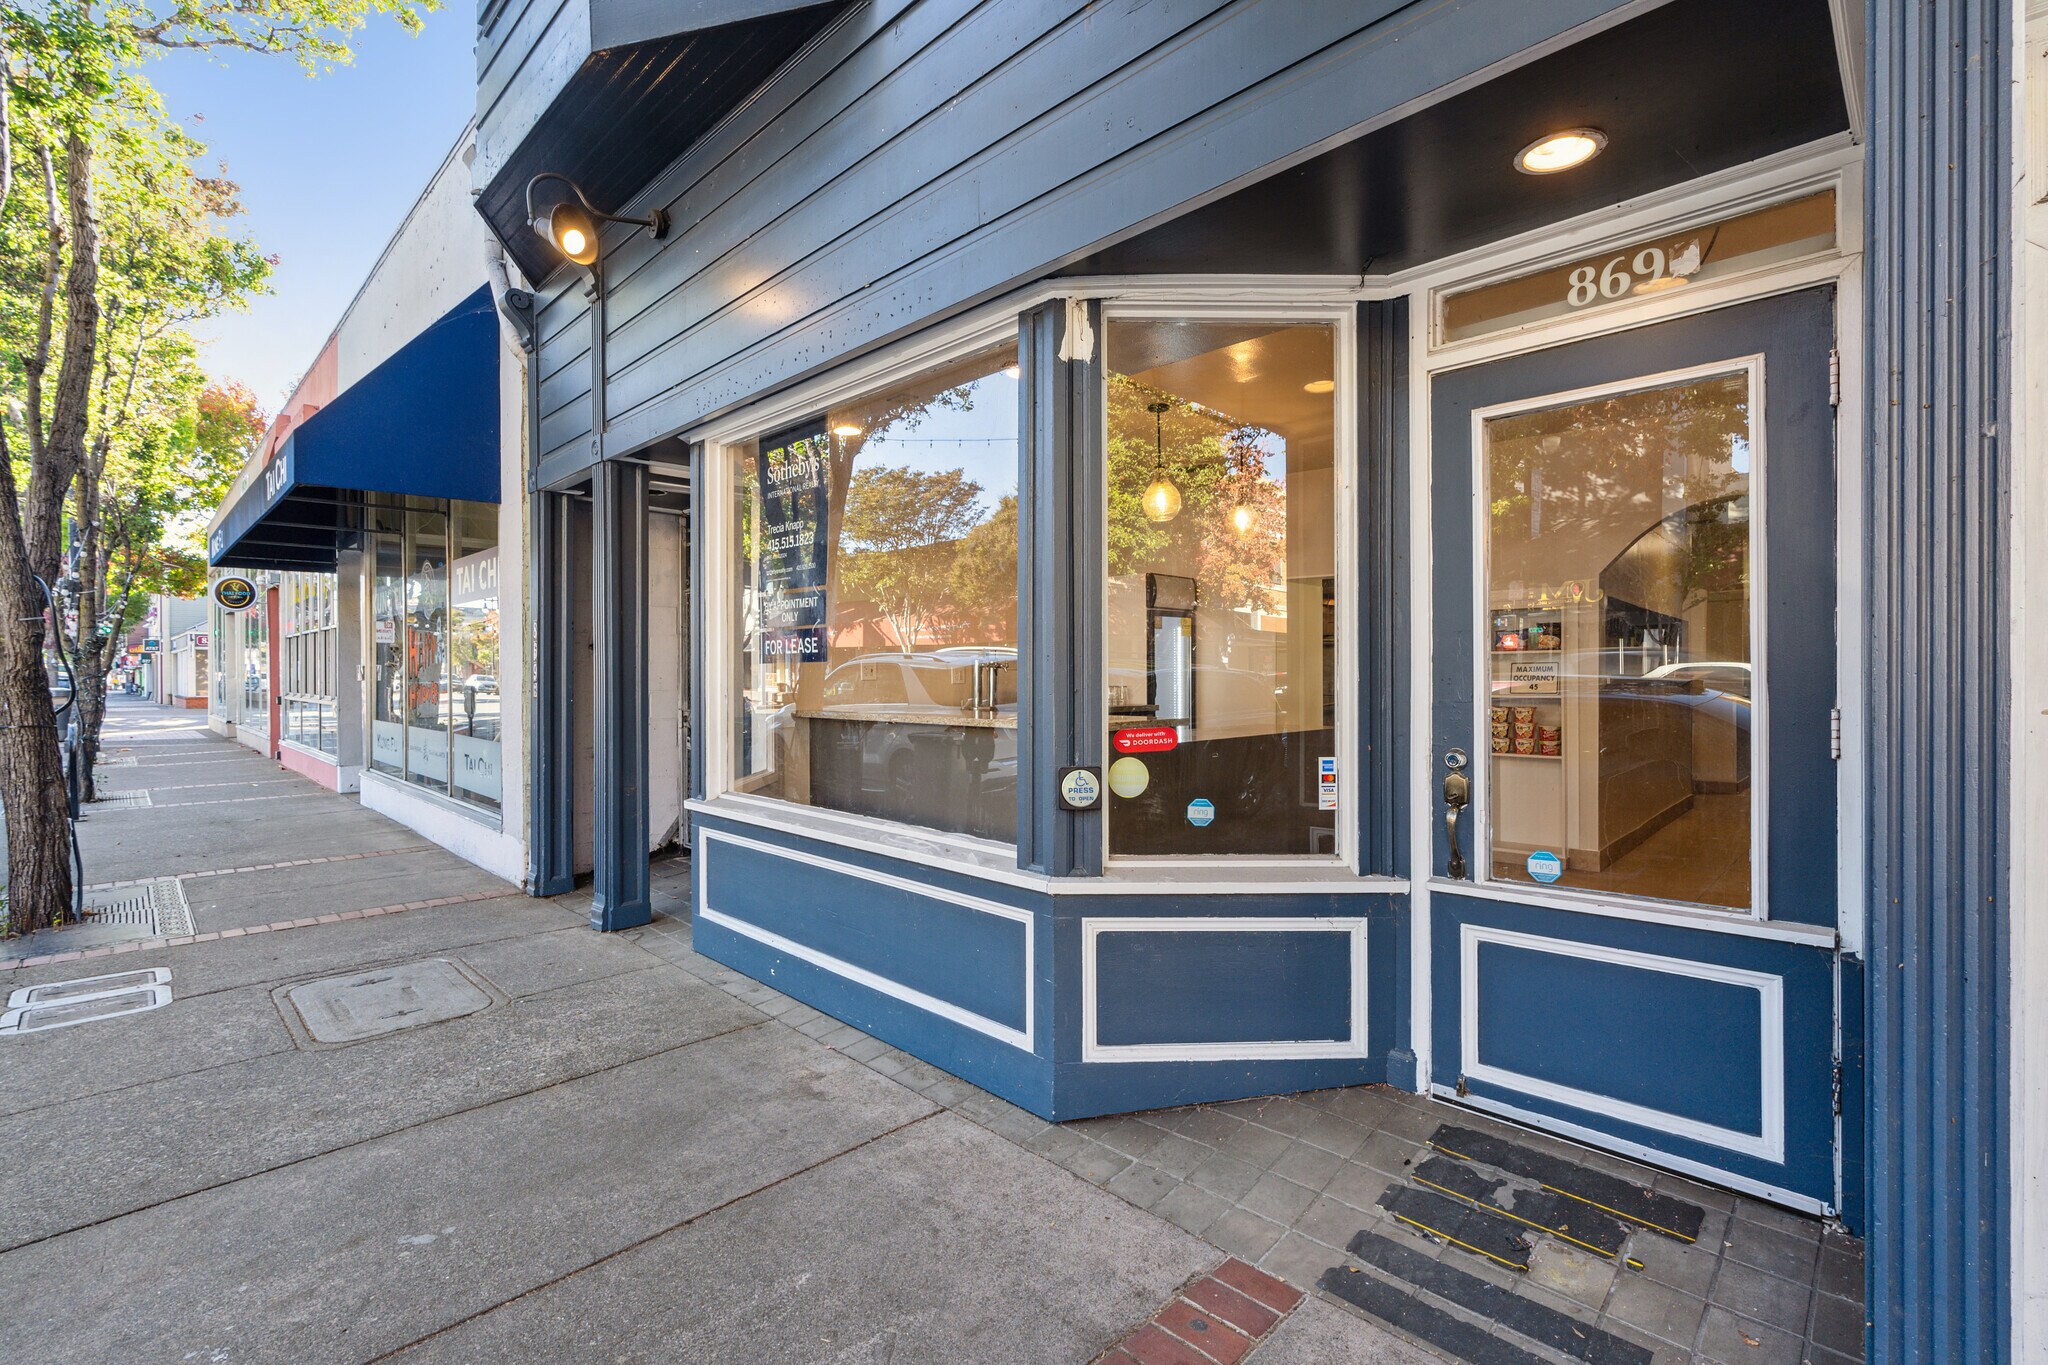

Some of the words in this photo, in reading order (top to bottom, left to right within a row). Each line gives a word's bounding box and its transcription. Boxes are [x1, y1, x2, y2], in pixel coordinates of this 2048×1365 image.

[1566, 247, 1665, 307] 869
[265, 470, 276, 501] TAI
[275, 455, 287, 490] CHI
[767, 485, 802, 499] INTERNATIONAL
[767, 523, 785, 534] Trecia
[785, 520, 804, 532] Knapp
[767, 531, 814, 551] 415.515.1823
[456, 563, 475, 596] TAI
[772, 596, 818, 611] APPOINTMENT
[781, 611, 799, 622] ONLY
[765, 639, 783, 655] FOR
[785, 636, 819, 655] LEASE
[1132, 738, 1173, 746] DOORDASH
[464, 753, 476, 771] TAI
[477, 757, 493, 776] CHI
[1193, 807, 1209, 818] ring
[1534, 861, 1553, 873] ring
